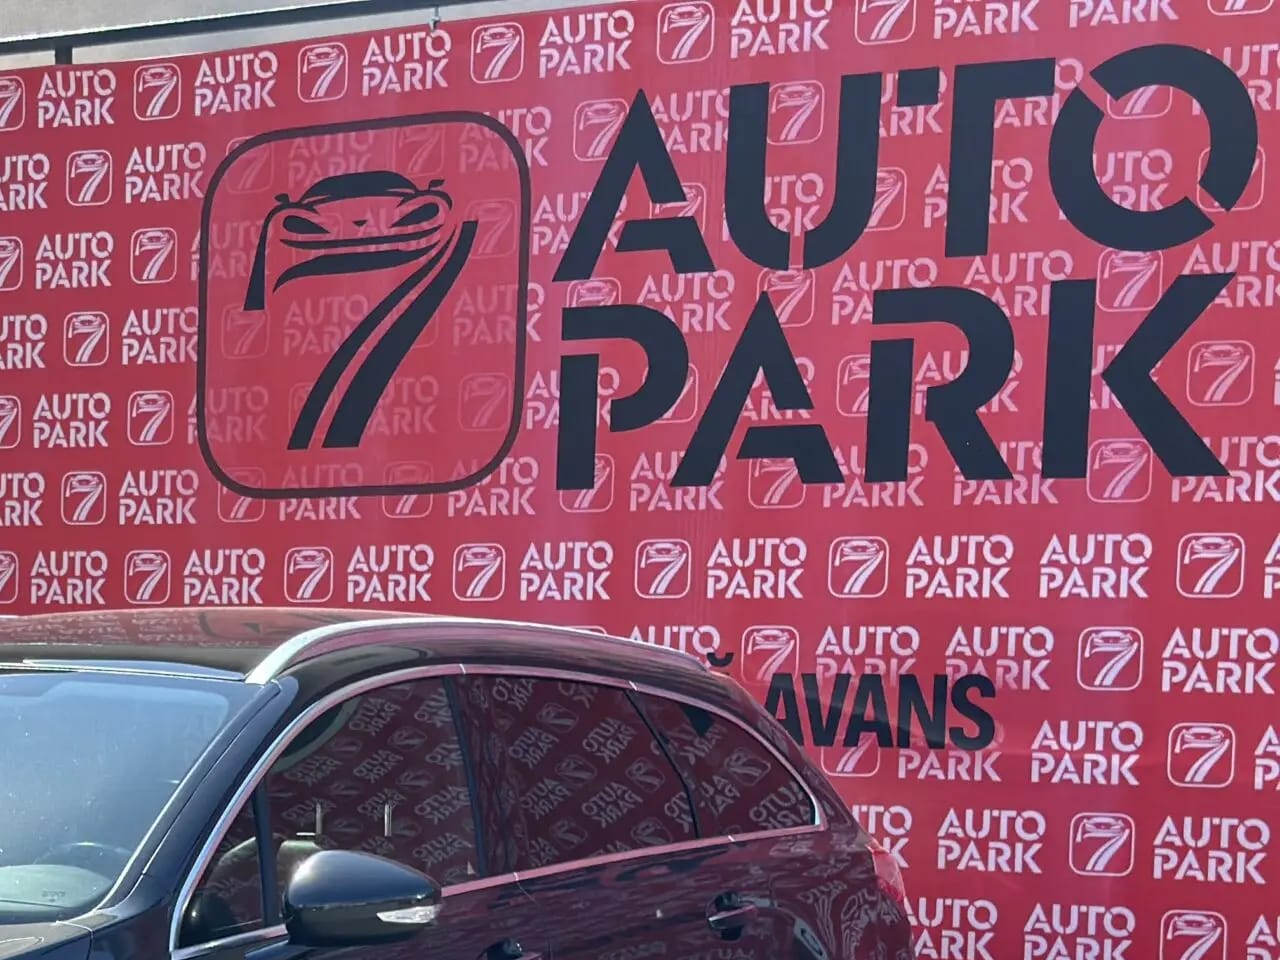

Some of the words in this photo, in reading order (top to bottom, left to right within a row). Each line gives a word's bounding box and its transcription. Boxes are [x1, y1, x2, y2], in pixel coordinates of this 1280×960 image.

[541, 9, 634, 46] AUTO
[934, 0, 1039, 39] PARK
[363, 28, 451, 66] AUTO
[731, 19, 829, 58] PARK
[196, 51, 277, 87] AUTO
[540, 40, 631, 78] PARK
[38, 67, 116, 102] AUTO
[362, 58, 448, 96] PARK
[38, 97, 114, 128] PARK
[195, 79, 275, 116] PARK
[125, 142, 206, 175] AUTO
[552, 43, 1258, 282] AUTO
[125, 171, 204, 204] PARK
[35, 231, 114, 261] AUTO
[36, 259, 111, 289] PARK
[832, 258, 937, 292] AUTO
[963, 250, 1073, 285] AUTO
[637, 269, 735, 304] AUTO
[122, 307, 197, 336] AUTO
[122, 335, 197, 365] PARK
[556, 271, 1237, 490] PARK
[33, 392, 111, 420] AUTO
[33, 420, 109, 448] PARK
[119, 469, 199, 496] AUTO
[629, 480, 725, 511] PARK
[823, 480, 925, 508] PARK
[953, 476, 1060, 506] PARK
[119, 497, 196, 525] PARK
[448, 487, 537, 517] PARK
[31, 550, 108, 576] AUTO
[184, 548, 265, 575] AUTO
[347, 544, 434, 572] AUTO
[520, 541, 613, 570] AUTO
[707, 537, 807, 567] AUTO
[906, 534, 1014, 566] AUTO
[1040, 533, 1152, 565] AUTO
[31, 578, 105, 604] PARK
[184, 577, 262, 604] PARK
[348, 572, 431, 602] PARK
[520, 571, 610, 601] PARK
[707, 568, 804, 599] PARK
[906, 567, 1010, 598] PARK
[1039, 566, 1149, 598] PARK
[816, 625, 920, 656] AUTO
[945, 626, 1054, 657] AUTO
[1162, 627, 1280, 660] AUTO
[1162, 660, 1276, 694] PARK
[764, 673, 997, 751] AVANS
[1031, 720, 1144, 752] AUTO
[898, 755, 1001, 782] PARK
[1031, 751, 1140, 785] PARK
[937, 808, 1046, 841] AUTO
[1153, 816, 1270, 850] AUTO
[938, 839, 1042, 874] PARK
[1153, 848, 1267, 884] PARK
[1024, 903, 1135, 937] AUTO
